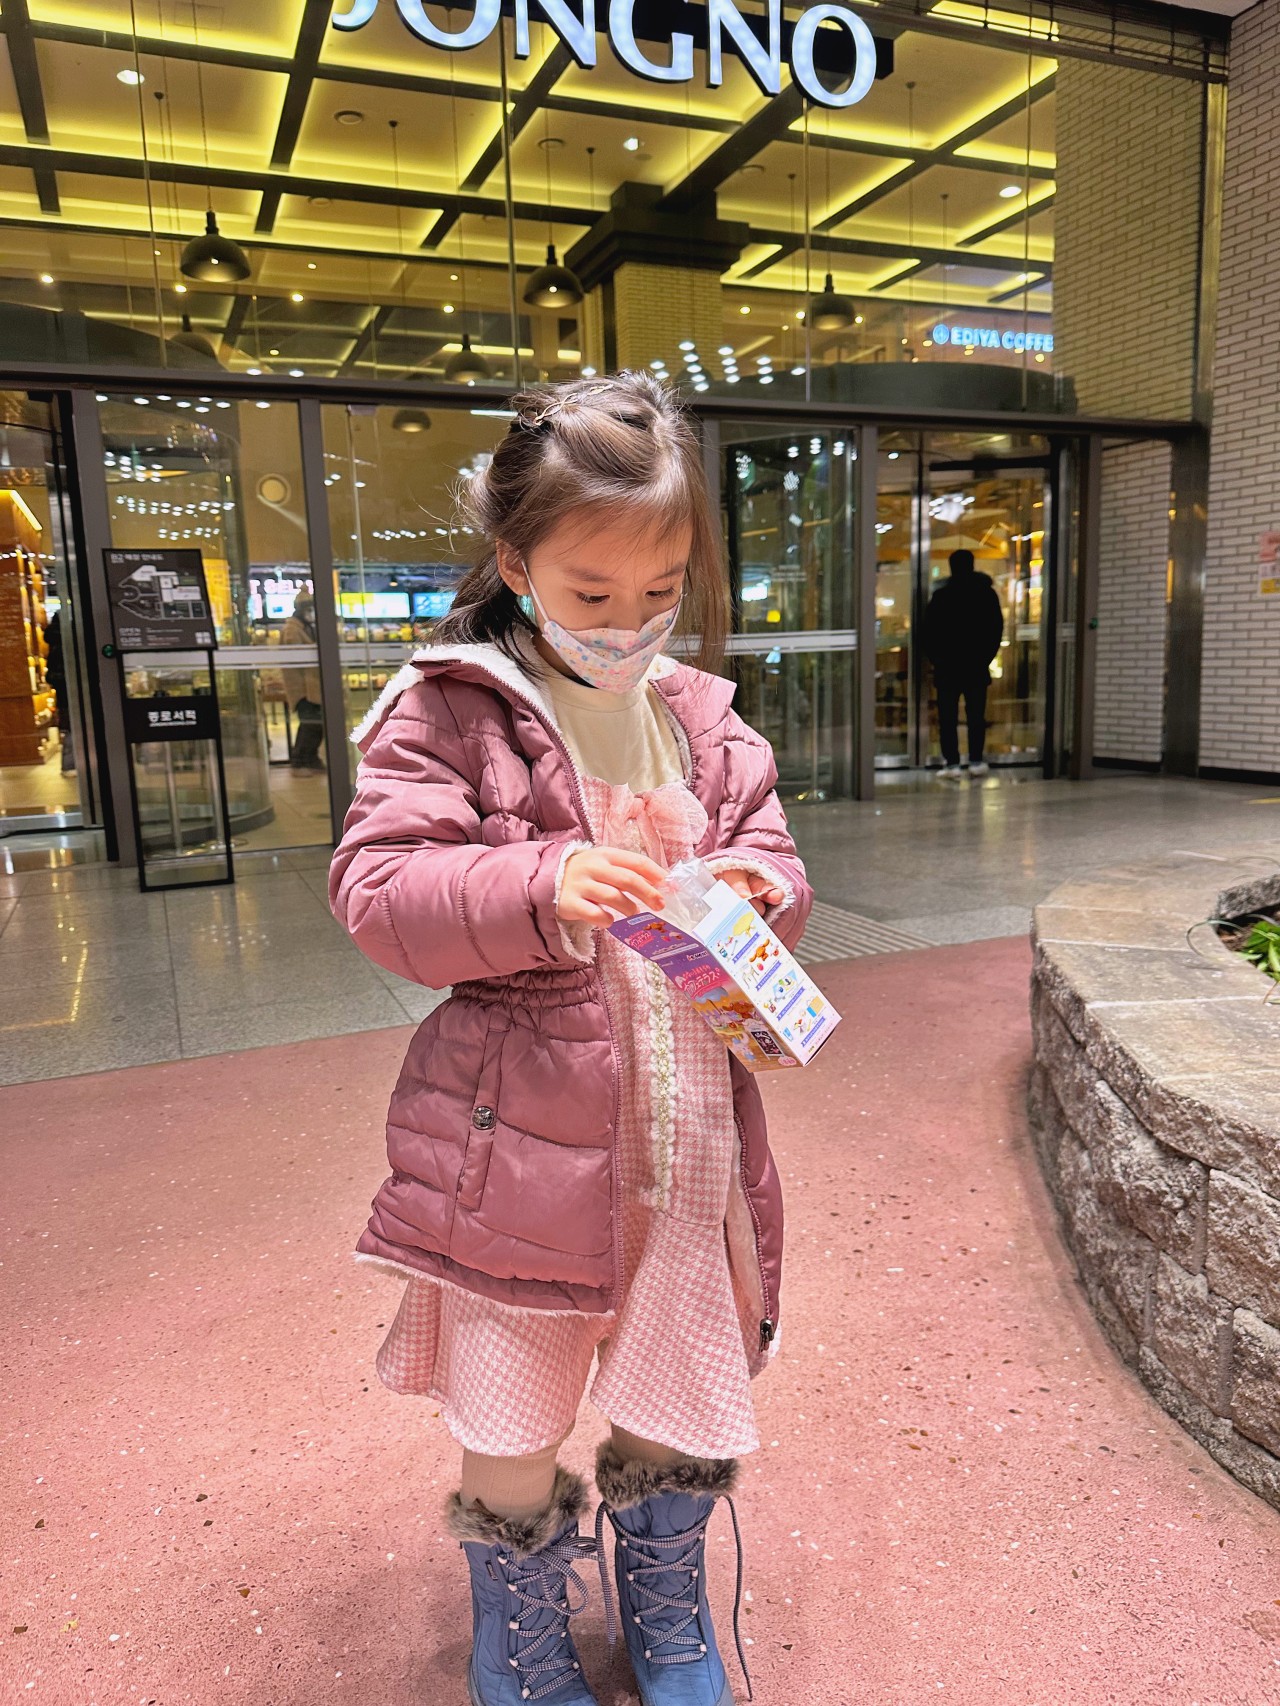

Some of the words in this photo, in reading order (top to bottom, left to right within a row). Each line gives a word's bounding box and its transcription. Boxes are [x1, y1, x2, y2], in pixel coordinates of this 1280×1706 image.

[332, 0, 877, 108] ONGNO
[950, 326, 1000, 348] EDIYA
[147, 709, 197, 723] 종로서적
